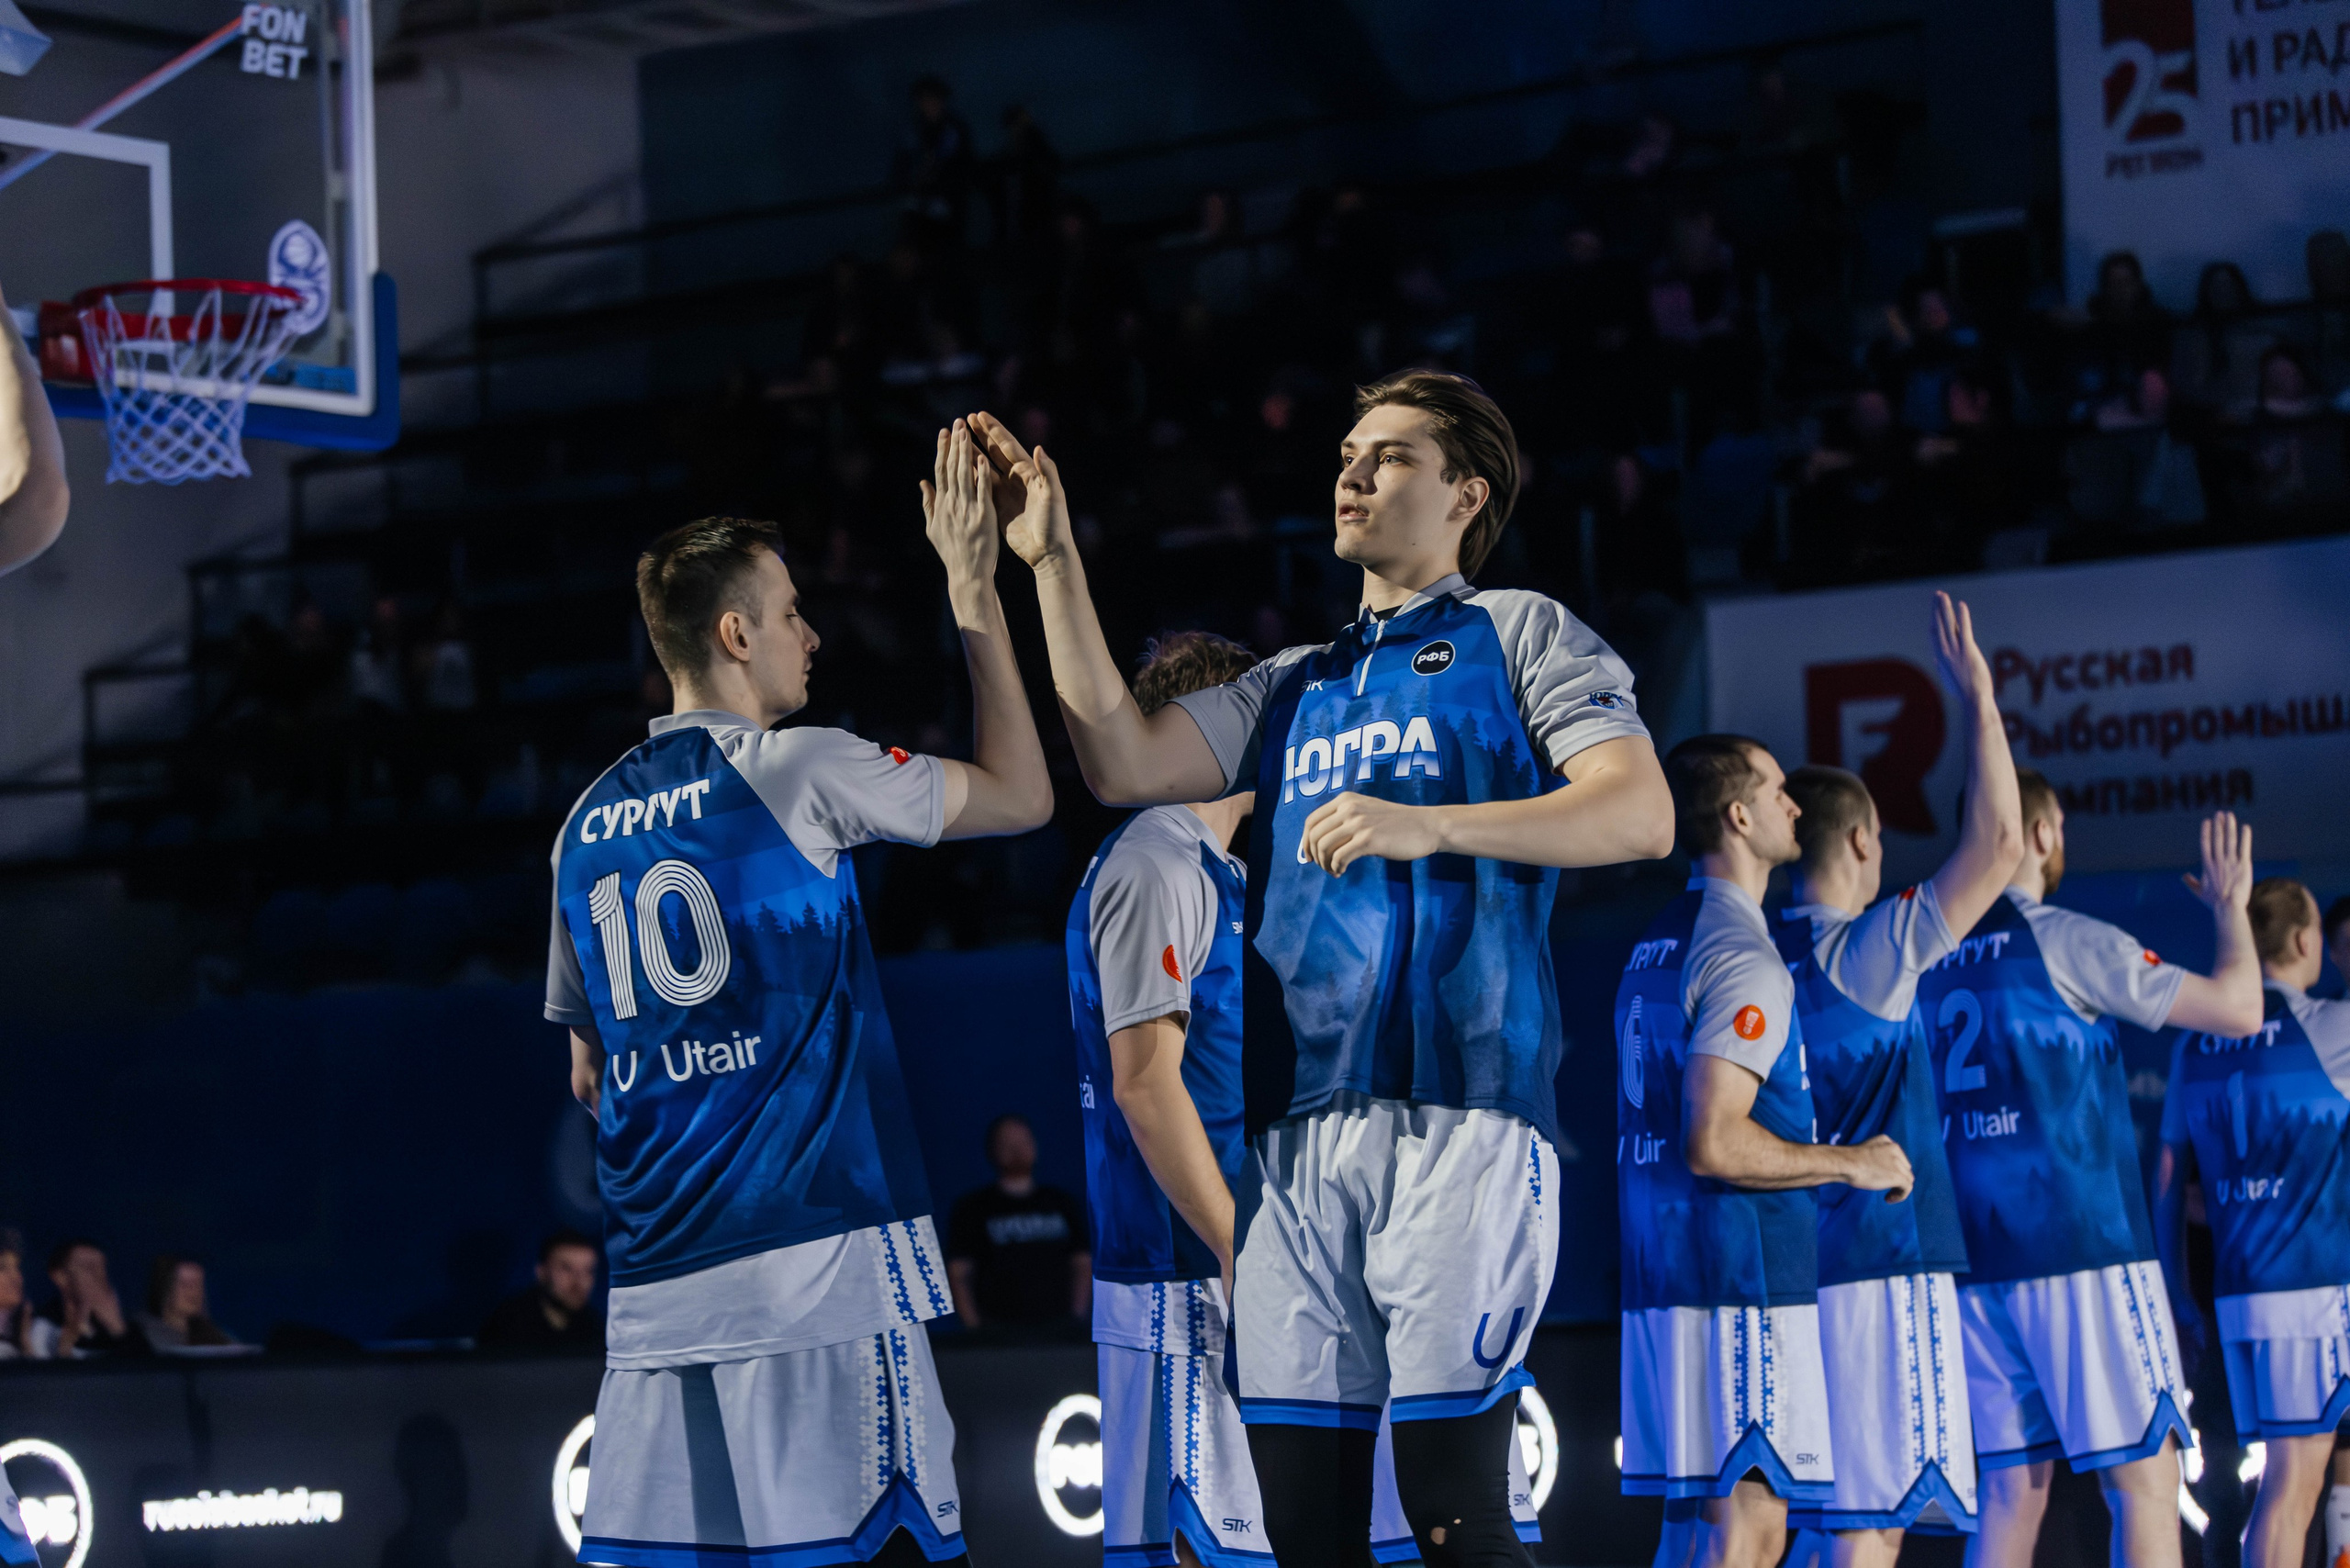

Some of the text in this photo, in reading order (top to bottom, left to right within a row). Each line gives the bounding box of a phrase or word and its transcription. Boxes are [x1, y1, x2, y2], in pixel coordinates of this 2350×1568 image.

[241, 4, 308, 44] FON
[241, 39, 308, 80] BET
[2228, 37, 2257, 79] И
[2102, 39, 2203, 142] 25
[1416, 651, 1450, 665] РФБ
[1994, 644, 2194, 705] Русская
[2003, 693, 2350, 760] Рыбопромыш
[1284, 715, 1442, 805] ЮГРА
[2059, 768, 2254, 815] мпания
[588, 859, 732, 1021] 10
[660, 1031, 761, 1082] Utair
[1938, 988, 1987, 1093] 2
[1963, 1105, 2020, 1140] Utair
[1796, 1453, 1819, 1465] STK
[1514, 1493, 1531, 1506] STK
[1222, 1518, 1252, 1533] STK
